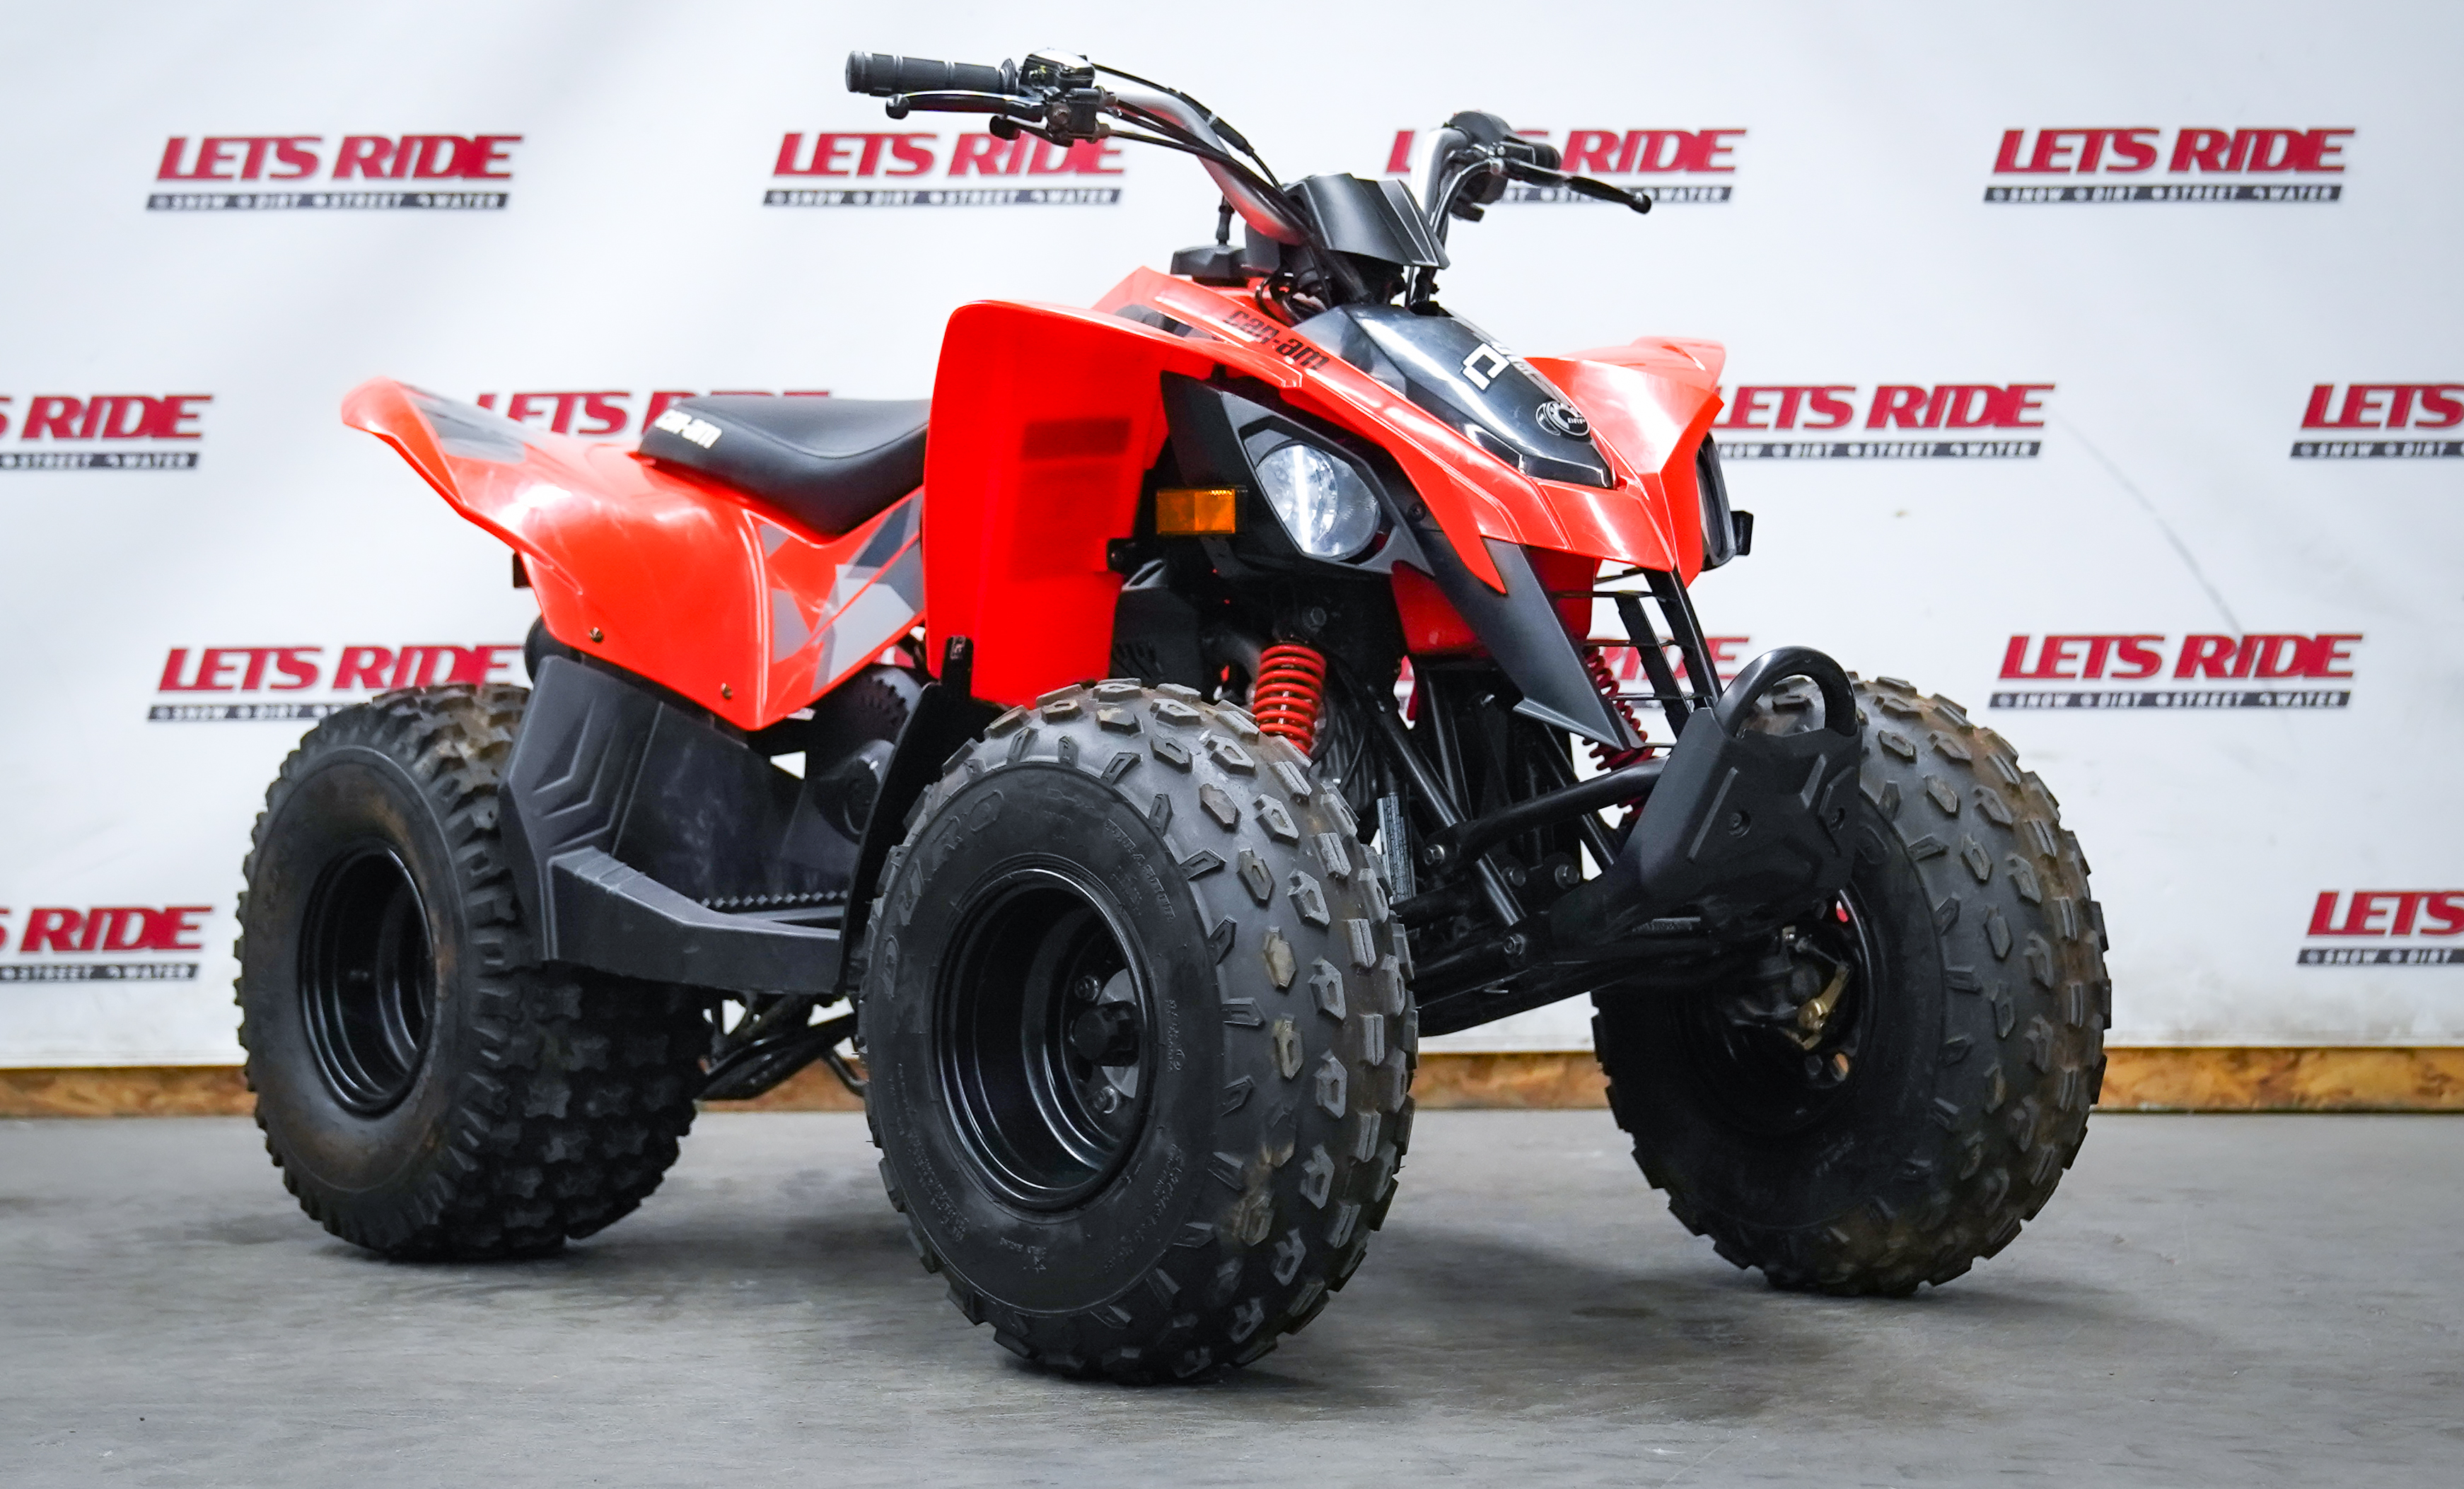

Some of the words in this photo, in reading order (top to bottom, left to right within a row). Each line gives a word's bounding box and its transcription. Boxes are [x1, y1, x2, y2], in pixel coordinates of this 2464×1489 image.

[156, 136, 322, 181] LETS
[332, 134, 522, 181] RIDE
[773, 132, 938, 177] LETS
[947, 132, 1125, 177] RIDE
[1560, 129, 1747, 173] RIDE
[1993, 129, 2160, 174] LETS
[2168, 127, 2356, 174] RIDE
[2009, 187, 2064, 202] SNOW
[2093, 187, 2138, 202] DIRT
[2168, 187, 2240, 202] STREET
[2267, 187, 2335, 202] WATER
[1224, 310, 1330, 370] can-am
[21, 395, 212, 439] RIDE
[1710, 385, 1856, 429] ETS
[1865, 384, 2055, 429] RIDE
[2301, 384, 2464, 428] LETS
[1719, 443, 1765, 458] NOW
[1791, 443, 1836, 458] DIRT
[1863, 443, 1936, 458] STREET
[1965, 443, 2033, 458] WATER
[2317, 442, 2374, 457] SNOW
[2401, 442, 2446, 457] DIRT
[158, 648, 322, 692] LETS
[332, 646, 523, 690] RIDE
[1997, 634, 2166, 679] LETS
[2173, 633, 2364, 679] RIDE
[2014, 692, 2071, 707] SNOW
[2100, 692, 2143, 707] DIRT
[2173, 692, 2245, 707] STREET
[2275, 692, 2341, 707] WATER
[20, 906, 212, 951] RIDE
[2307, 892, 2464, 935] LETS
[2323, 949, 2379, 964] SNOW
[2406, 949, 2452, 964] DIRT
